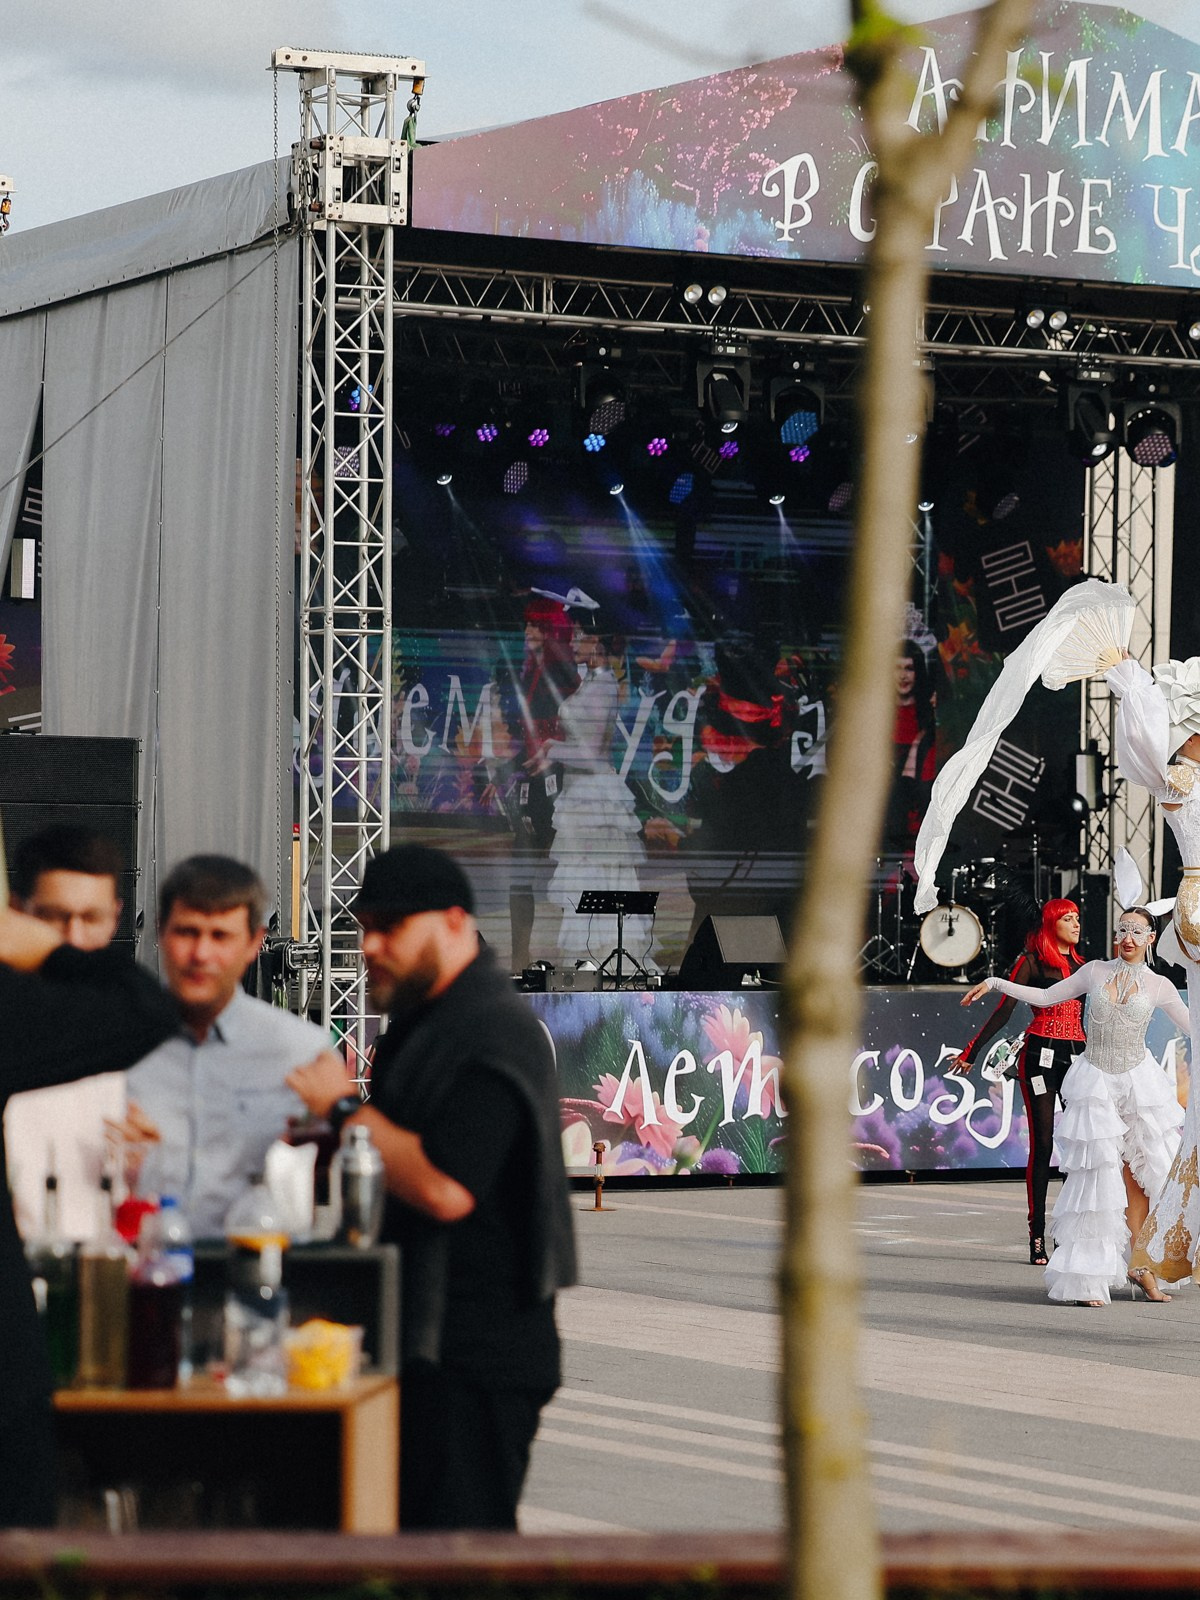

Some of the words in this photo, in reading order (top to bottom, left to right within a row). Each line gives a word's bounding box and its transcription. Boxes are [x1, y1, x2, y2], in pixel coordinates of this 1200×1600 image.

[762, 152, 820, 241] В
[849, 161, 1117, 261] СРАНЕ
[605, 1039, 790, 1130] Лет
